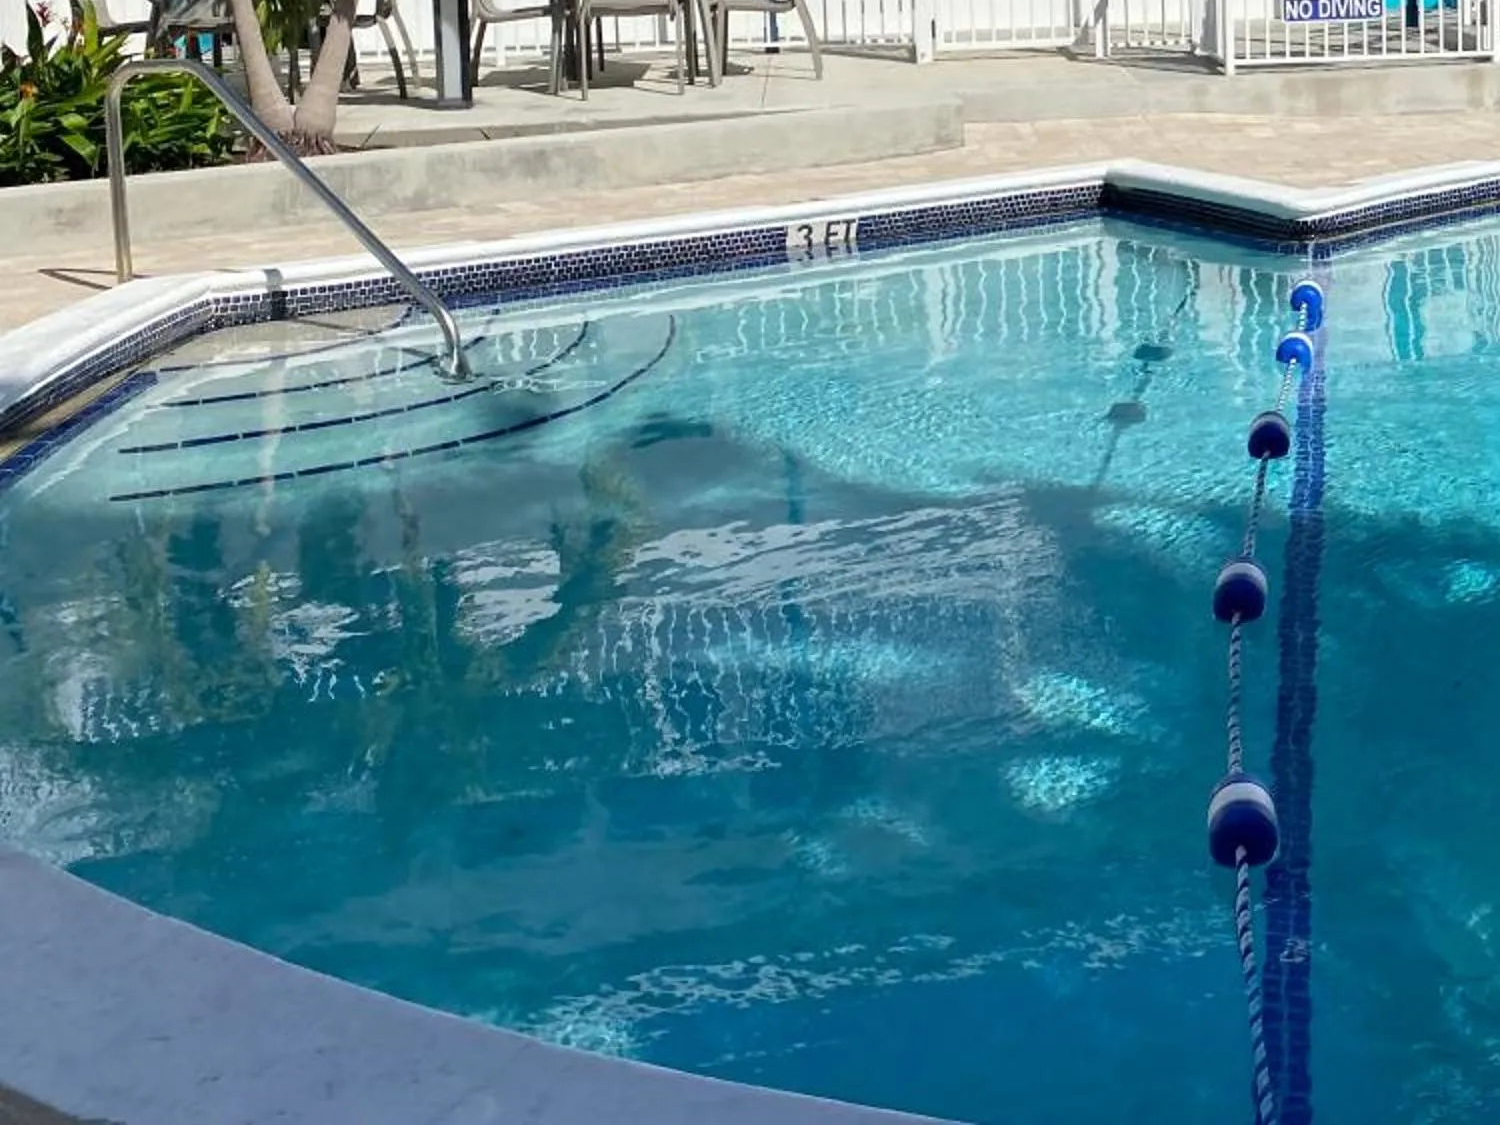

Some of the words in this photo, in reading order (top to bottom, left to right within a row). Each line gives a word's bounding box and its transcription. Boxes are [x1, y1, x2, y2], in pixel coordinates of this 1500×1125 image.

[1286, 0, 1313, 19] NO
[797, 223, 814, 247] 3
[824, 219, 857, 246] FT
